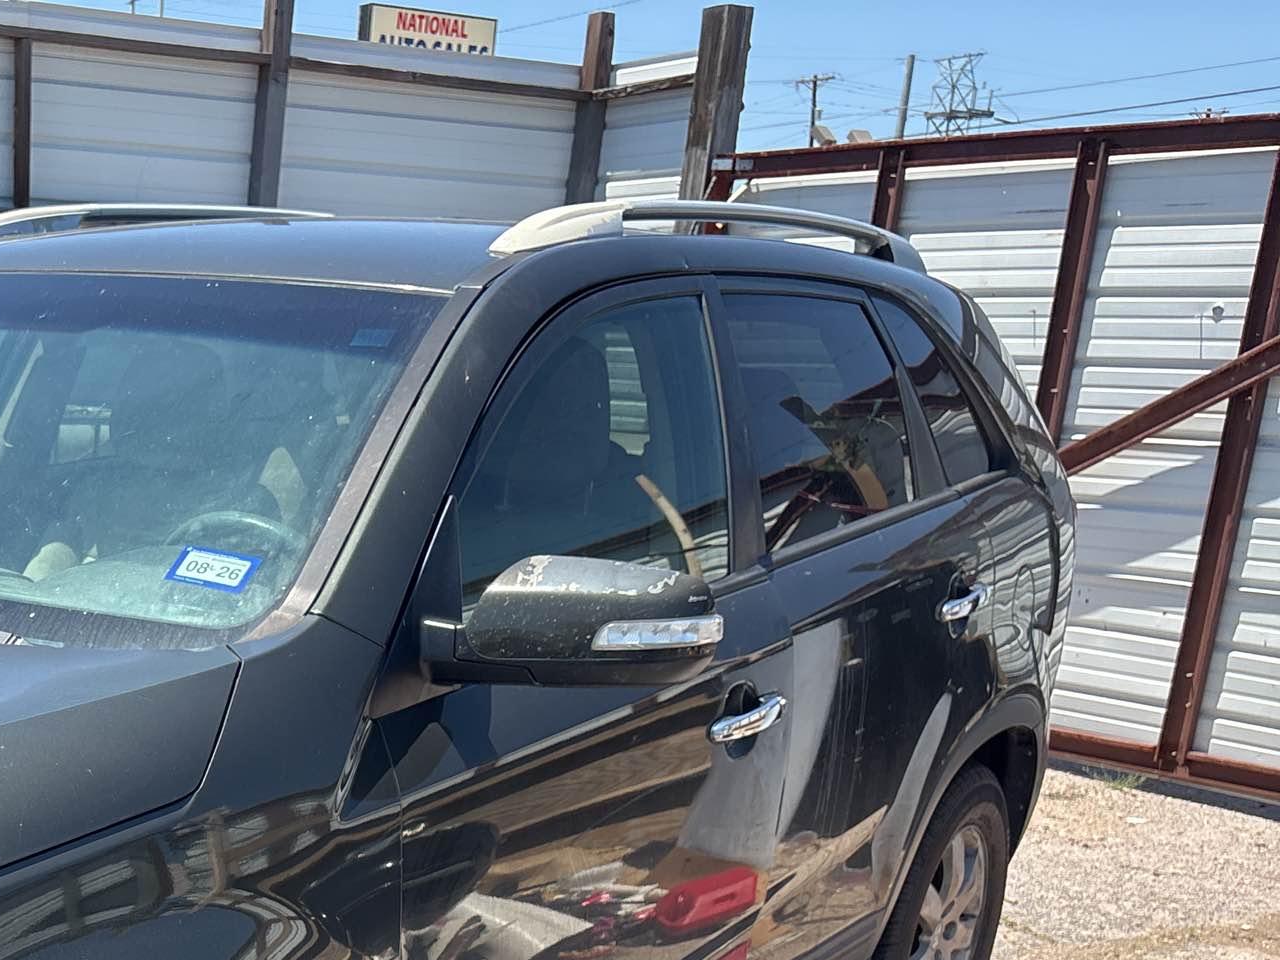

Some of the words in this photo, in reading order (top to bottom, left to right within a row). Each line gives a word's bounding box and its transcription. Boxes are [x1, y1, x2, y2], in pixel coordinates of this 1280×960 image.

[396, 12, 468, 38] NATIONAL
[186, 560, 210, 574] 08
[216, 566, 241, 580] 26
